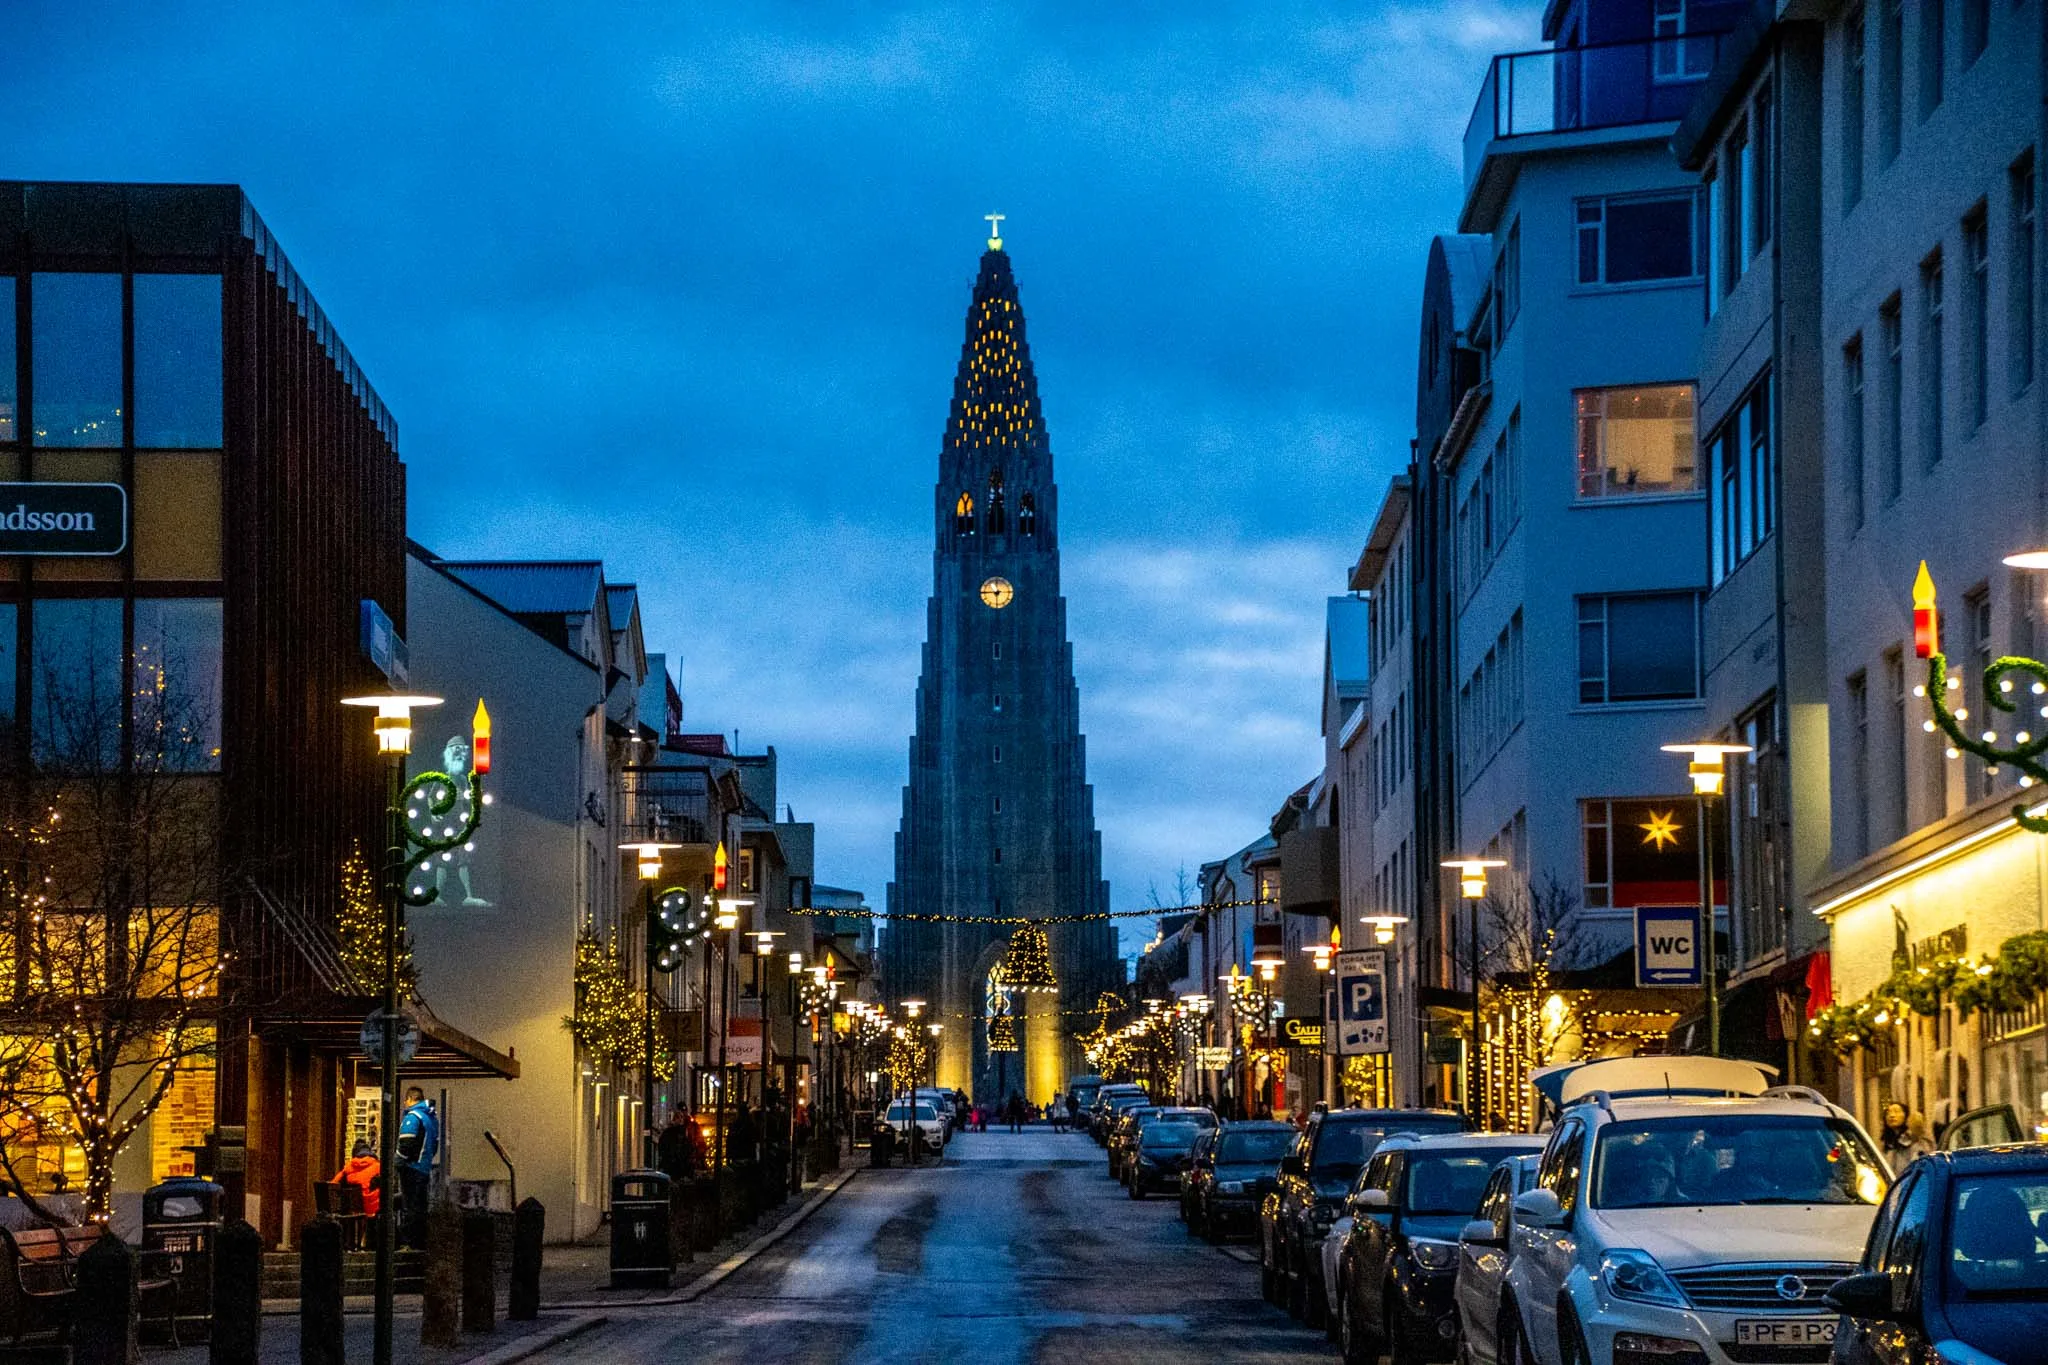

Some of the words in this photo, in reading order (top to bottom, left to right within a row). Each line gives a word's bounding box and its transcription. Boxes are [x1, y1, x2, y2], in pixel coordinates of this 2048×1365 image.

[1650, 936, 1690, 955] WC
[1352, 982, 1372, 1013] P
[1755, 1324, 1785, 1341] PF
